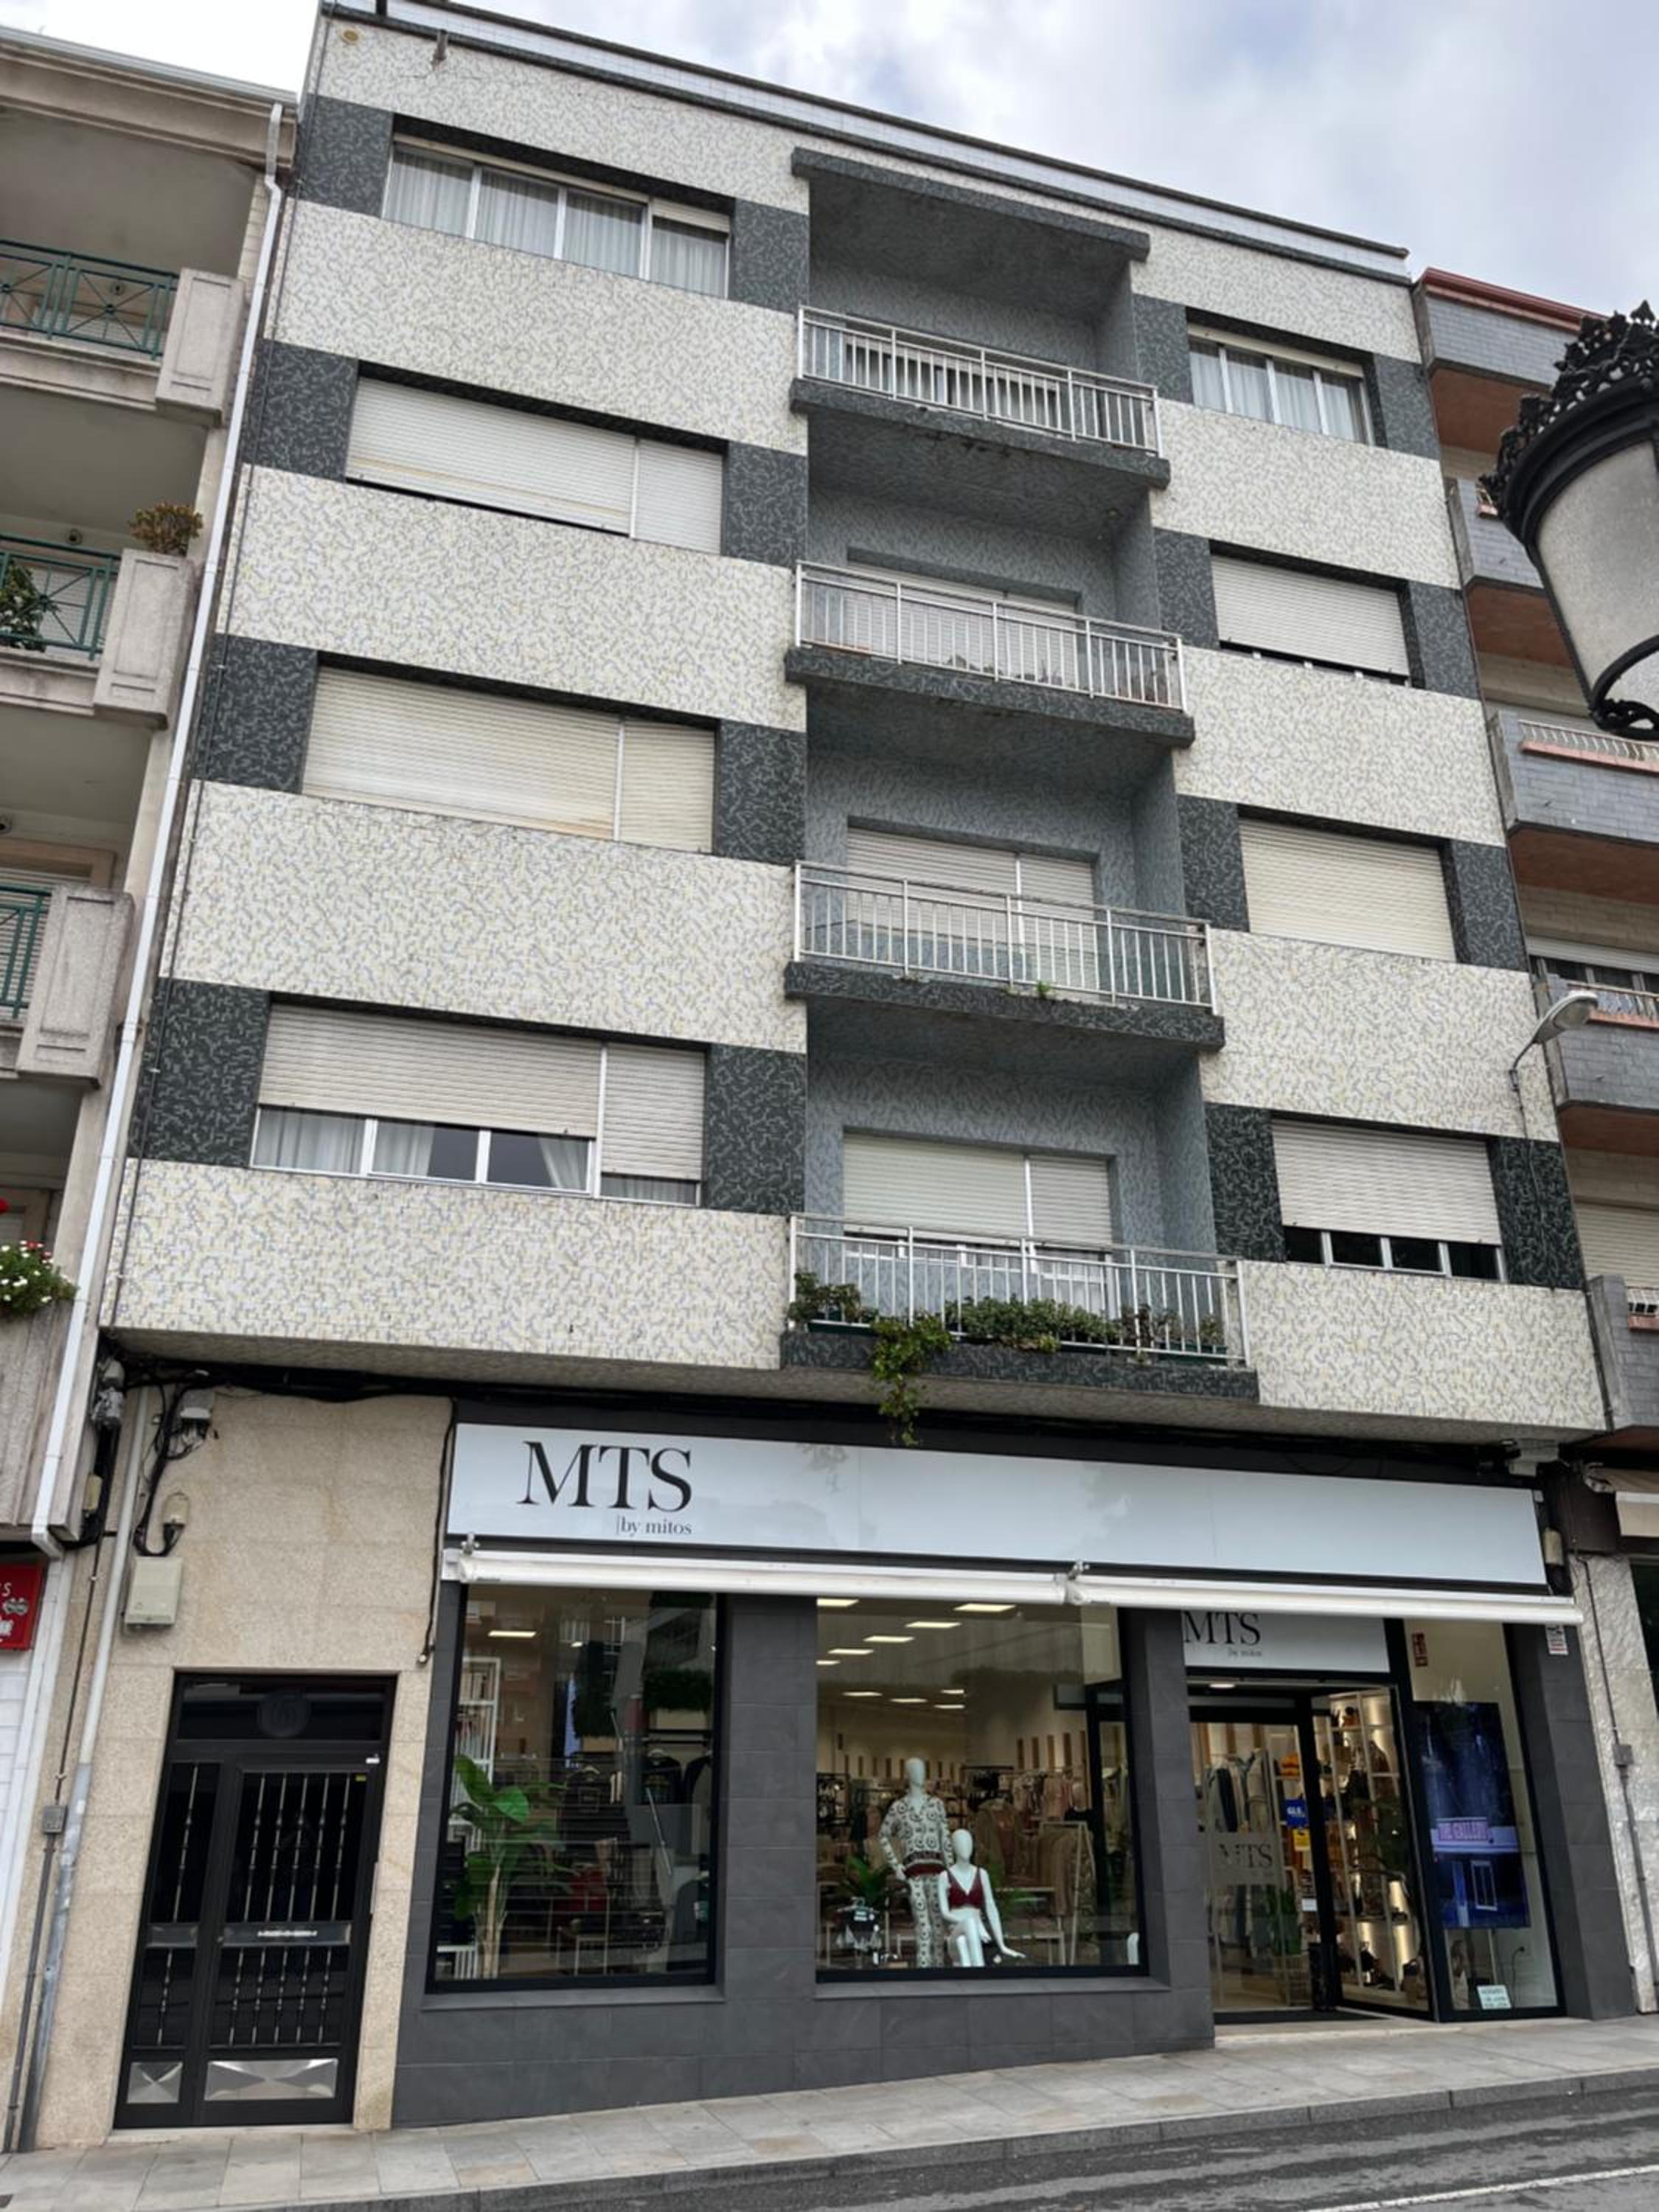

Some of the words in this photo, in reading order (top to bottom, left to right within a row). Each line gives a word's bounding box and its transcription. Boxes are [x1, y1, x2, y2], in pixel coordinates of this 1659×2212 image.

[516, 1441, 692, 1512] MTS
[646, 1518, 692, 1534] mitos
[1182, 1611, 1260, 1646] MTS
